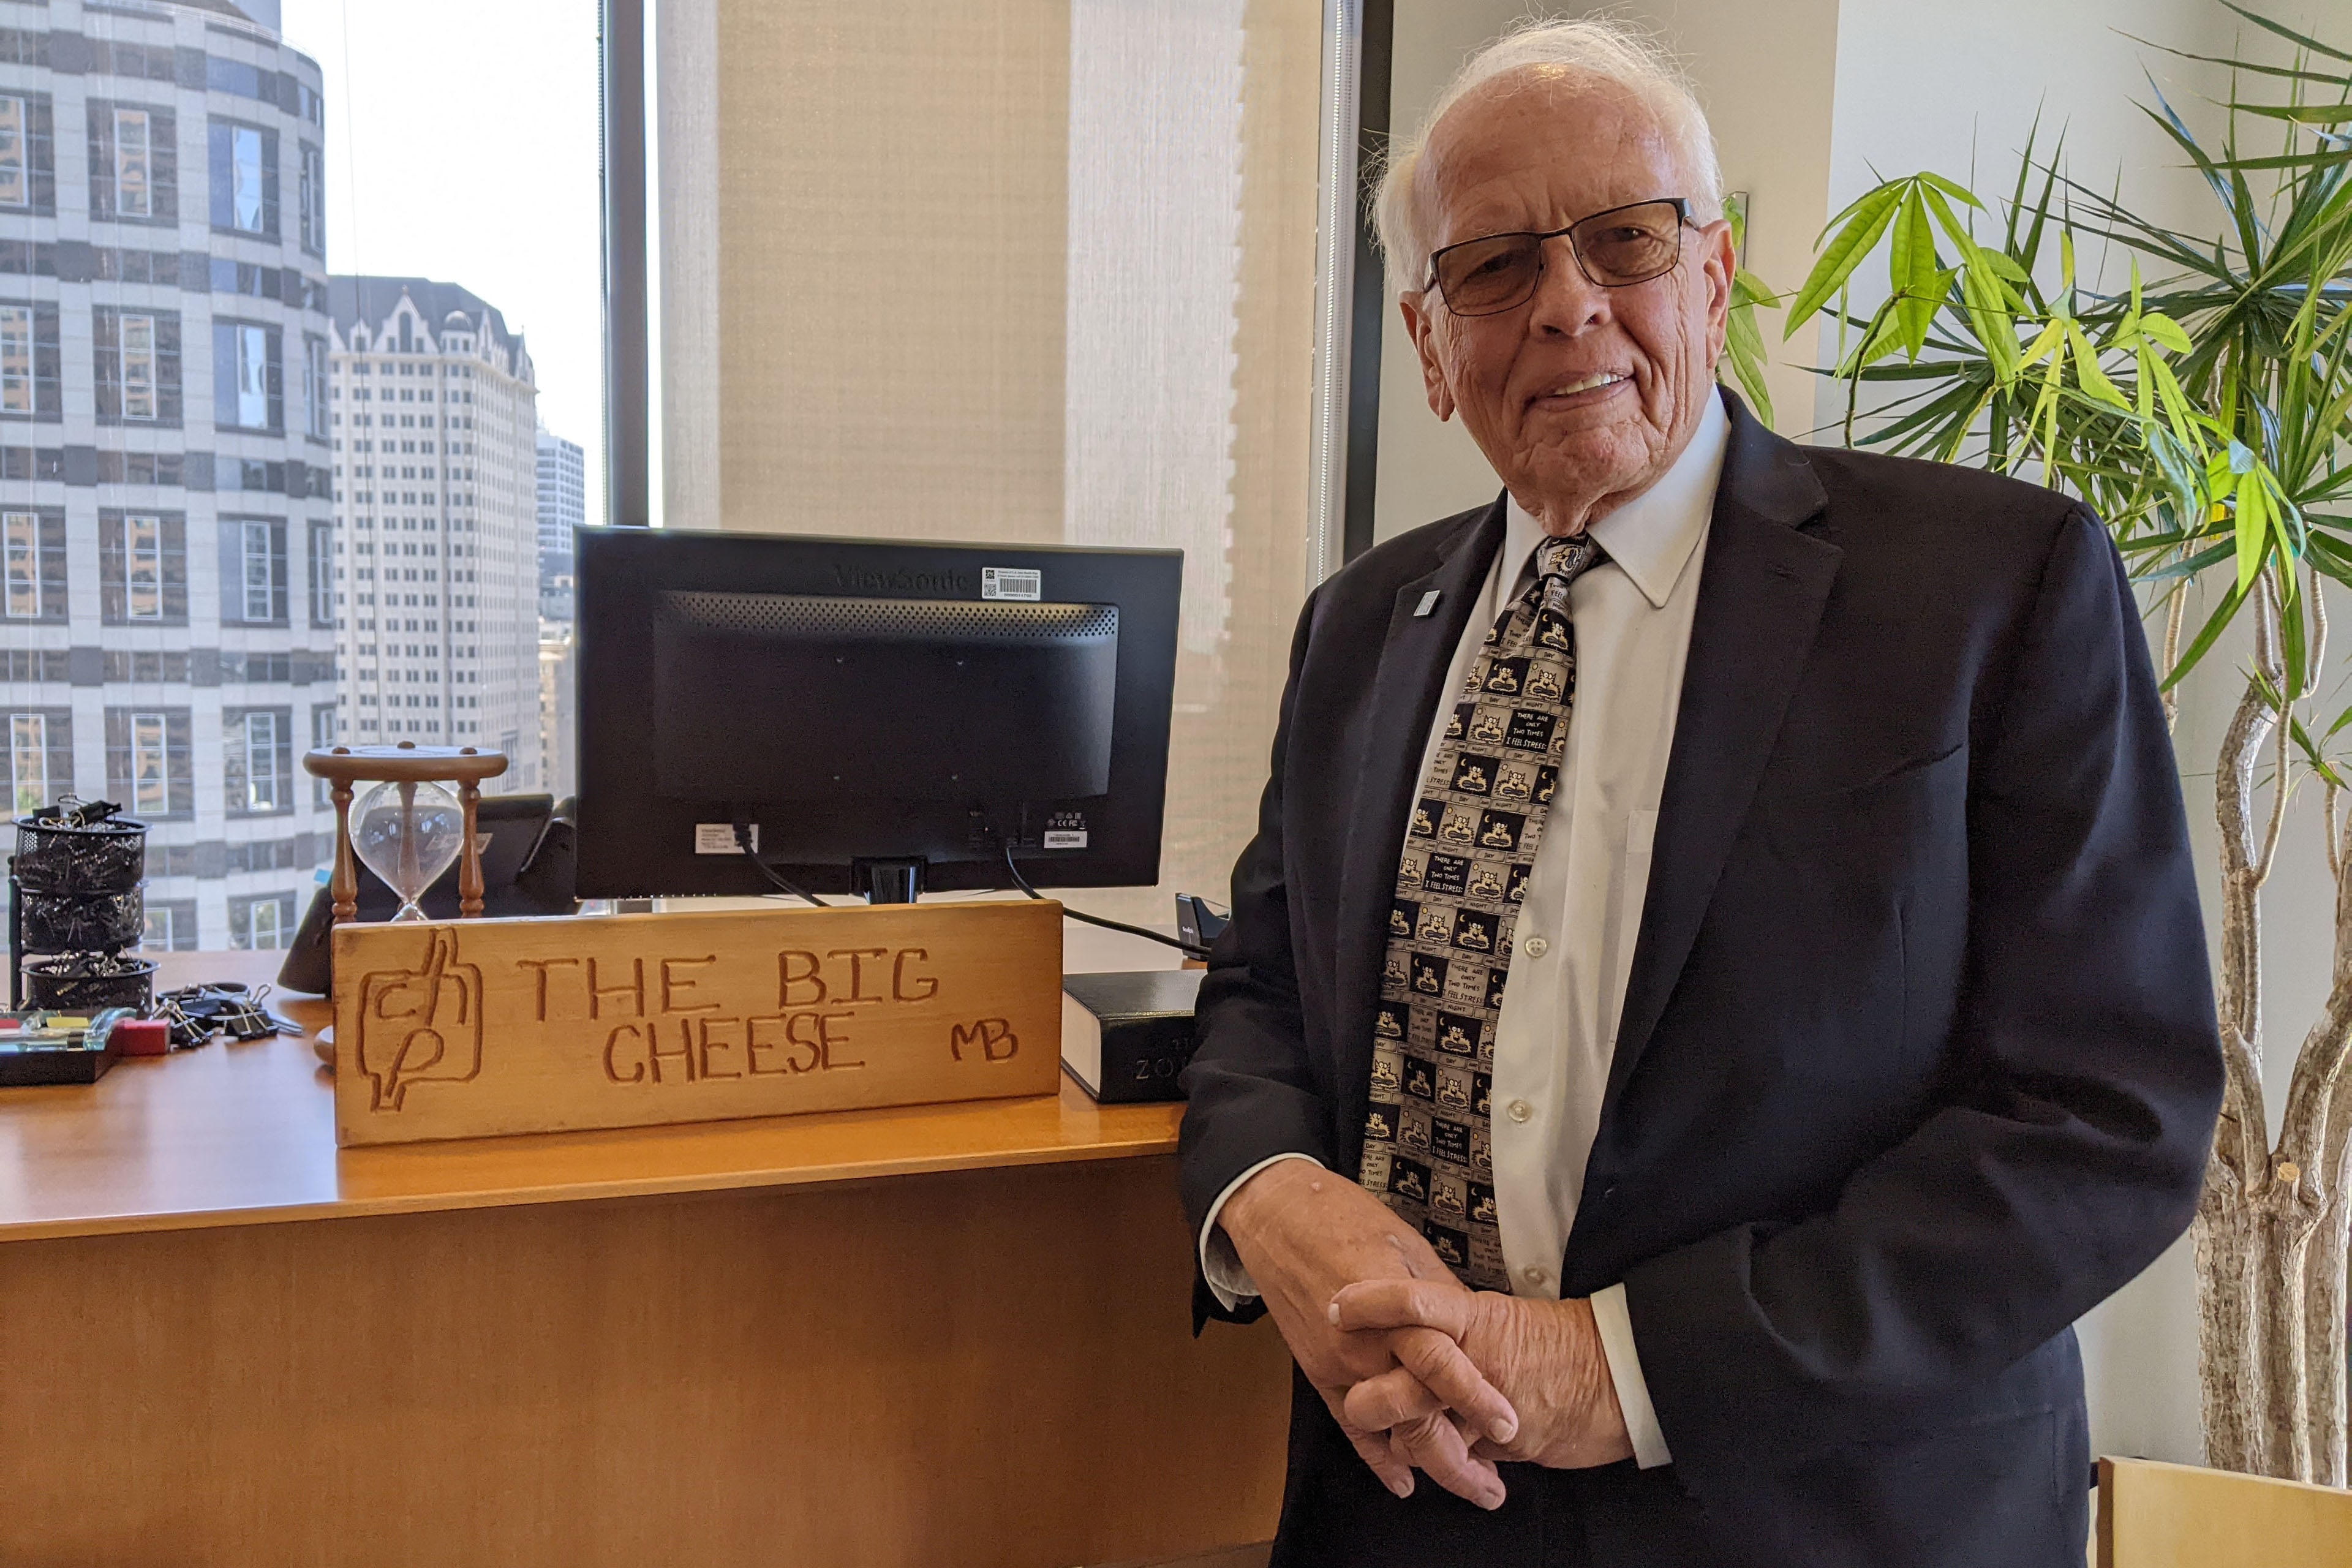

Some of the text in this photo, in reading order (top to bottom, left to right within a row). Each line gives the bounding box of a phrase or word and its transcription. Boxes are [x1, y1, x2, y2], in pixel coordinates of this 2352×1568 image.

[1517, 712, 1534, 721] THERE
[1526, 729, 1544, 738] TIMES
[1506, 737, 1548, 750] I FEEL STRESS:
[1434, 856, 1450, 865] THERE
[1444, 873, 1460, 881] TIMES
[1425, 880, 1463, 893] I FEEL STRESS:
[1451, 963, 1468, 973] THERE
[517, 947, 938, 1022] THE BIG
[1463, 982, 1480, 992] TIMES
[1447, 990, 1458, 1000] FEEL
[951, 1017, 1019, 1062] MB
[603, 1011, 865, 1084] CHEESE
[1135, 1058, 1186, 1080] ZO
[1436, 1120, 1450, 1131] THERE
[1447, 1140, 1462, 1150] TIMES
